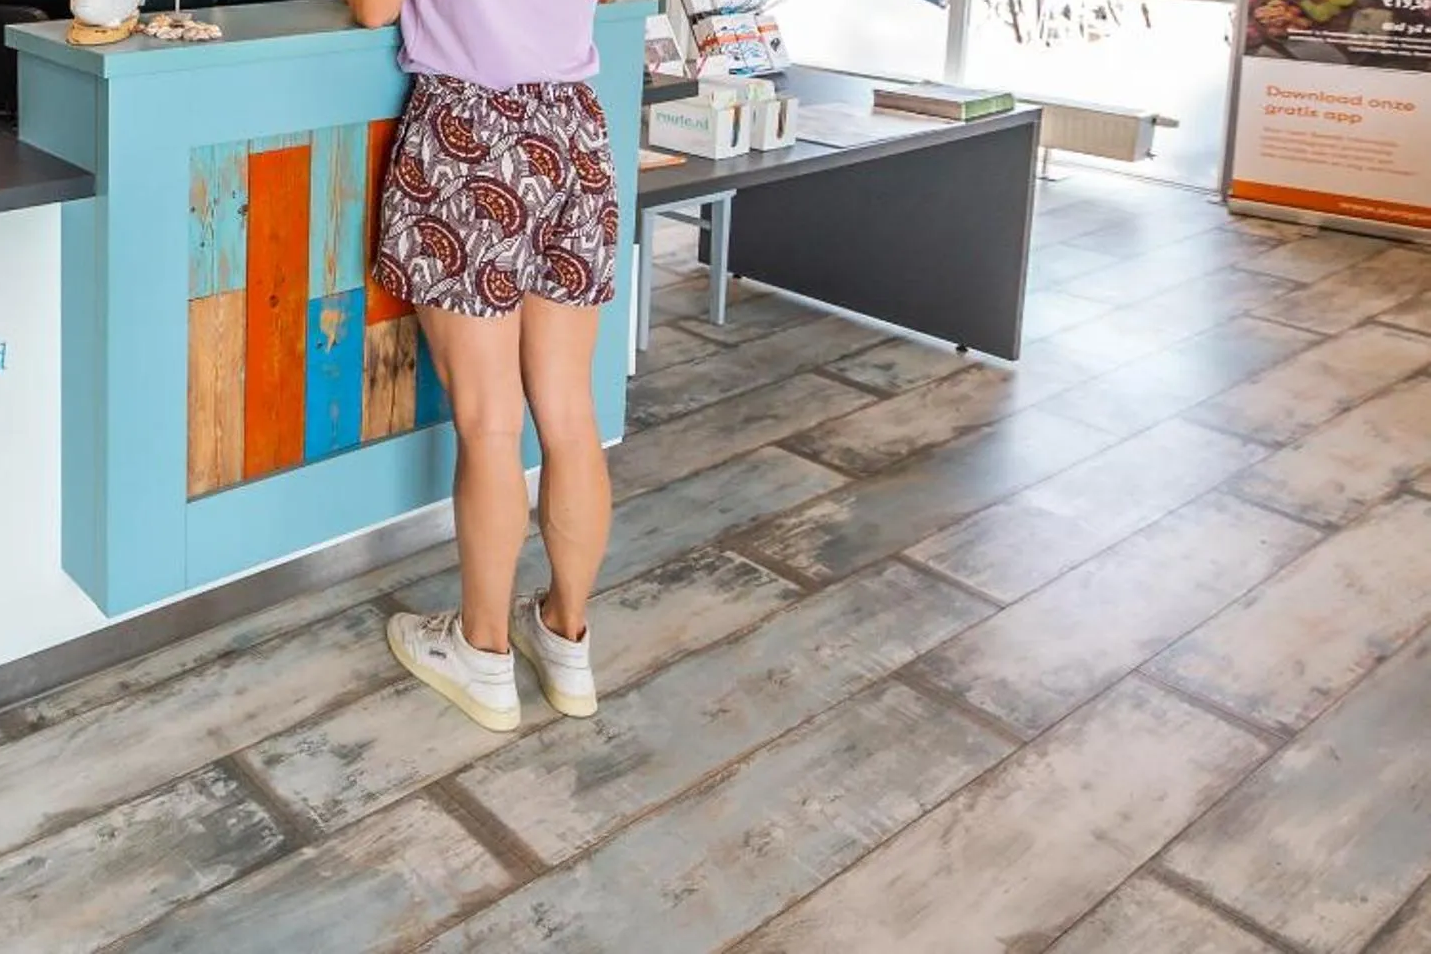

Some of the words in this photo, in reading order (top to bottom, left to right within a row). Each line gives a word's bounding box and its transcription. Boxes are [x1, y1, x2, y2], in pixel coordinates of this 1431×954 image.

[1266, 85, 1363, 106] Download
[1368, 98, 1416, 112] onze
[1264, 103, 1318, 118] gratis
[1323, 110, 1363, 124] app
